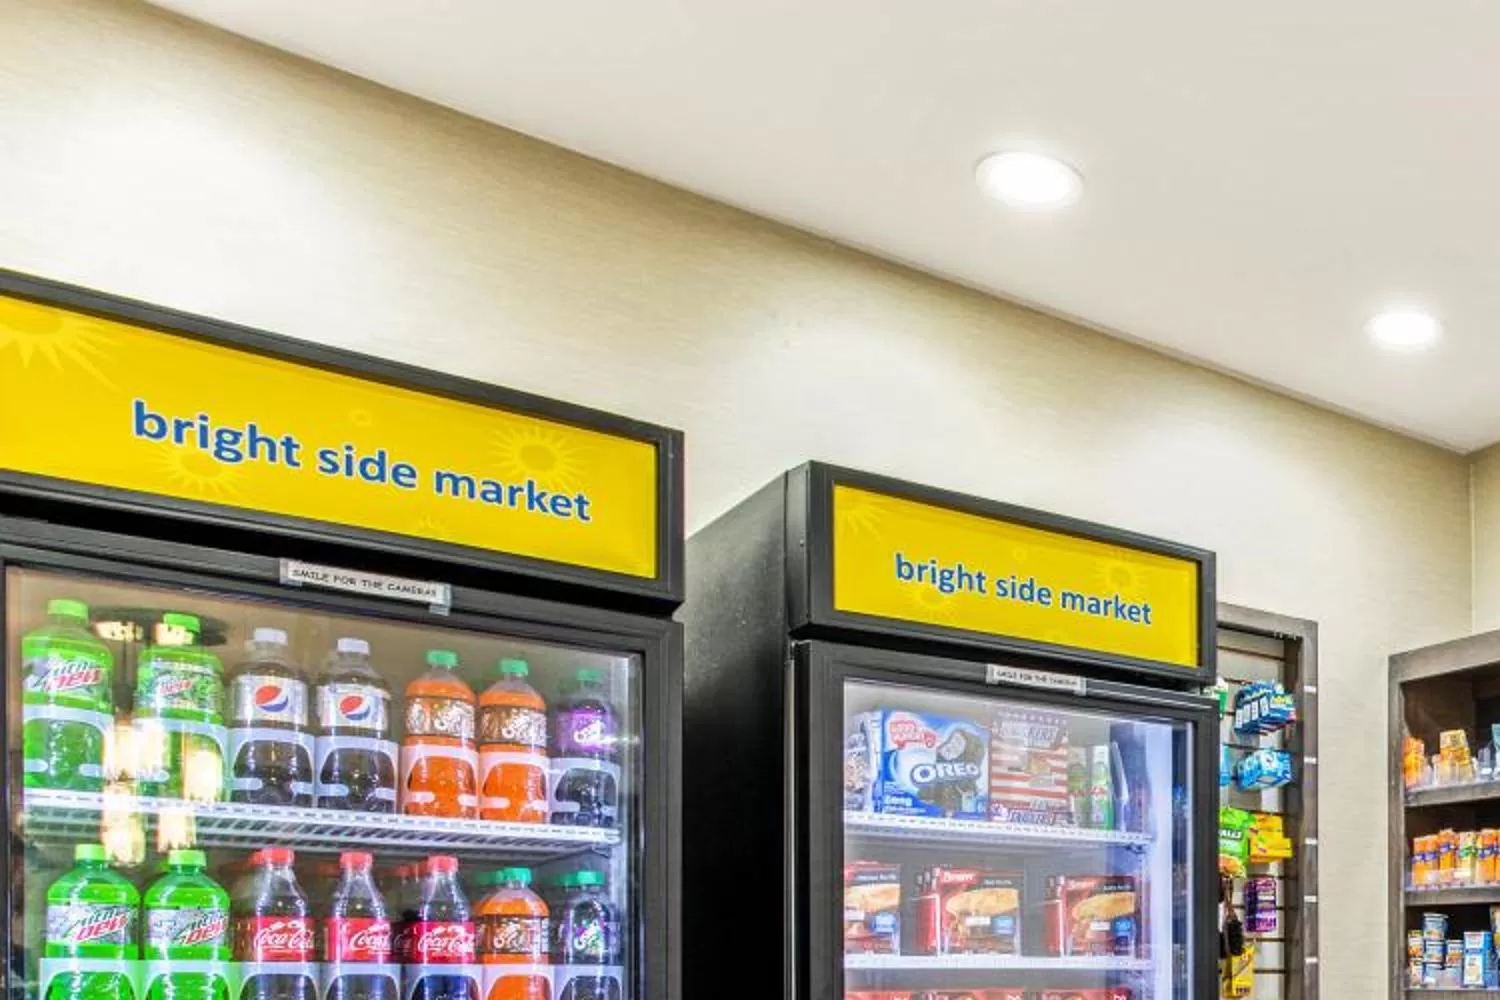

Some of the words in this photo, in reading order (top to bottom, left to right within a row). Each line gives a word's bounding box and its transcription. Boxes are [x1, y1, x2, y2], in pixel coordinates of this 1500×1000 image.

[133, 400, 301, 467] bright
[318, 444, 418, 489] side
[434, 470, 592, 522] market
[292, 569, 330, 583] SMILE
[333, 575, 359, 587] FOR
[362, 580, 384, 591] THE
[895, 553, 988, 594] bright
[996, 575, 1052, 605] side
[1060, 591, 1152, 625] market
[911, 762, 979, 785] OREO
